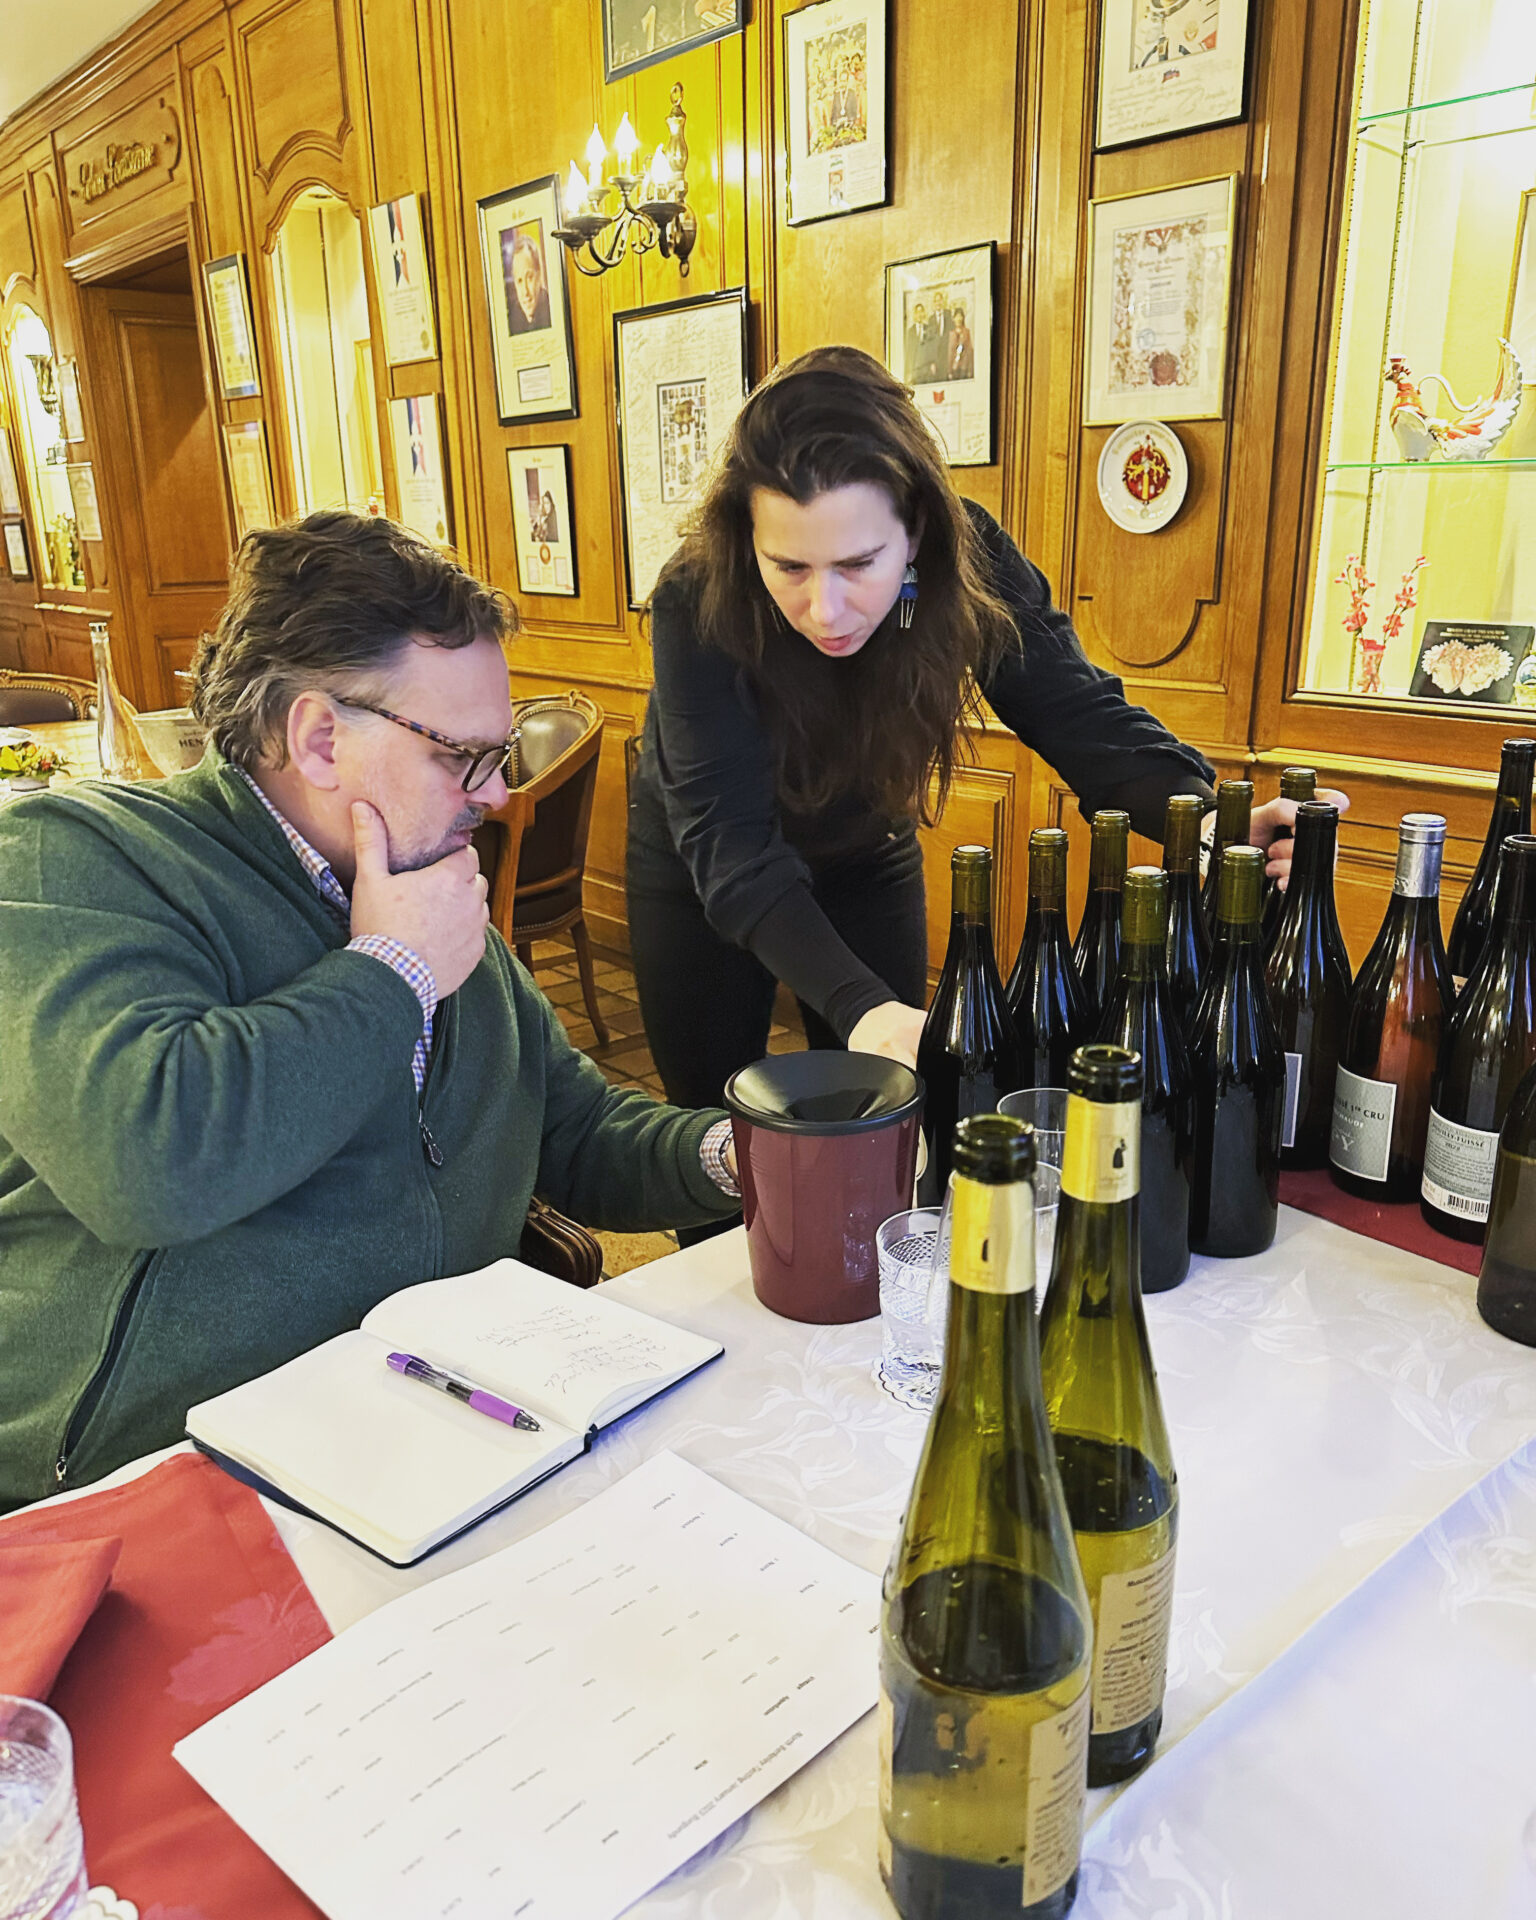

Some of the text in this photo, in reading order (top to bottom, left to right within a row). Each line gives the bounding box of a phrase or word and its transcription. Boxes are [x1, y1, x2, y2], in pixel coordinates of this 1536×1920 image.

[1363, 1109, 1385, 1121] CRU
[785, 1731, 803, 1746] North
[759, 1745, 787, 1766] Berkeley
[737, 1766, 762, 1783] Tasting
